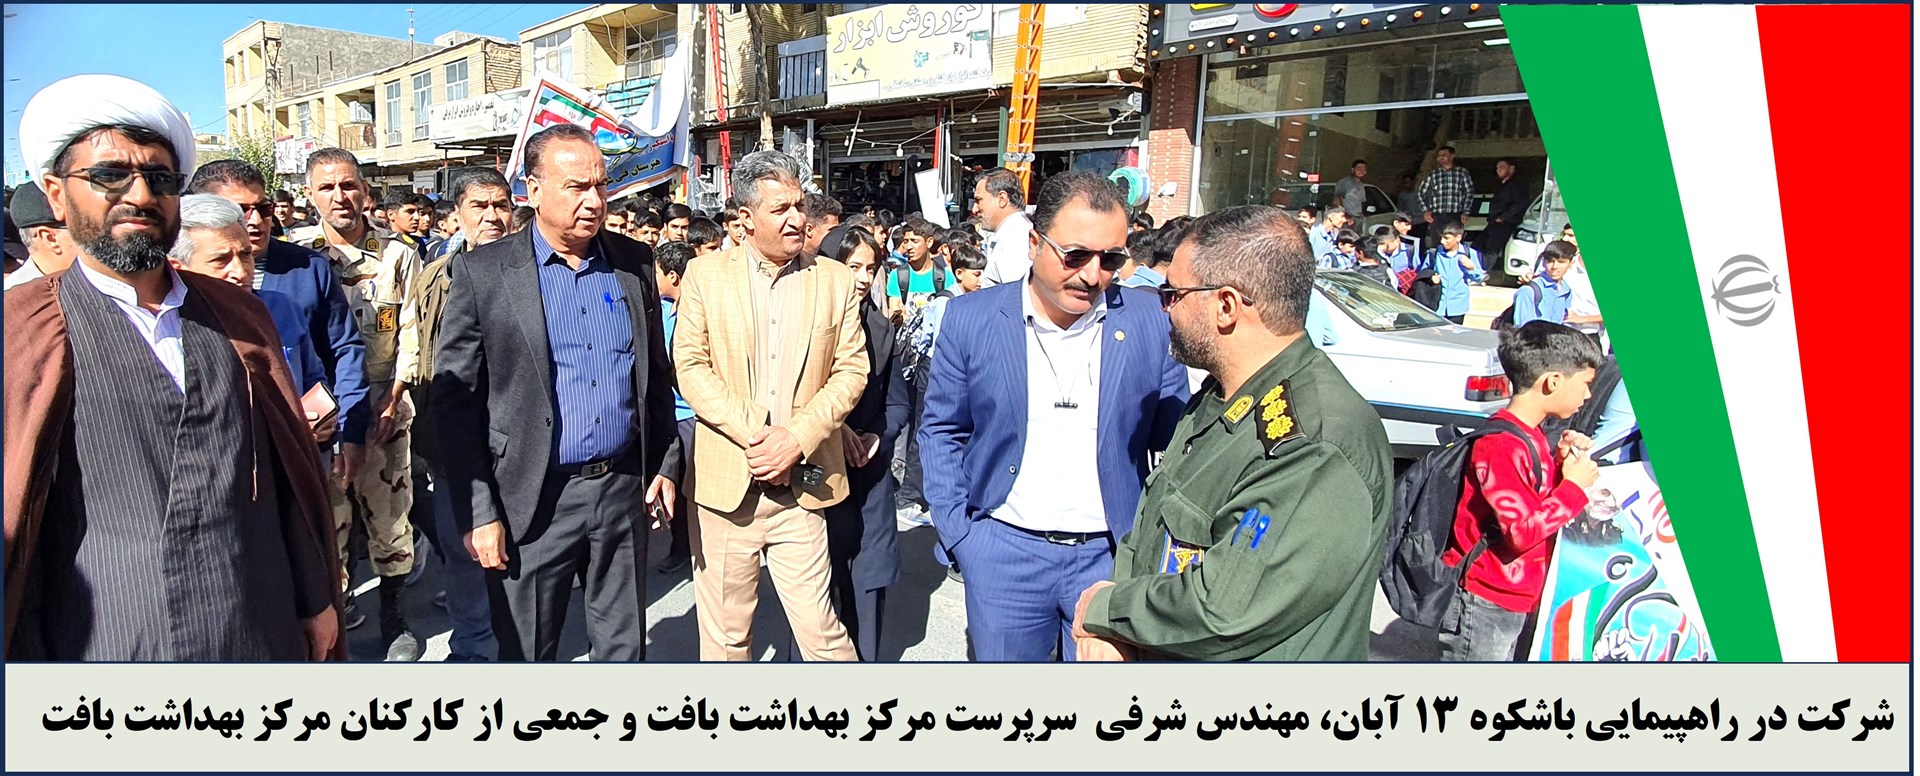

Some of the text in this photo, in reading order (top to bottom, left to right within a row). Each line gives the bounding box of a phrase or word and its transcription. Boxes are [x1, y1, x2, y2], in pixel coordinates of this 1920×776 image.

[833, 10, 884, 53] ابزار
[615, 168, 629, 183] فنی
[631, 158, 661, 177] هنرستان
